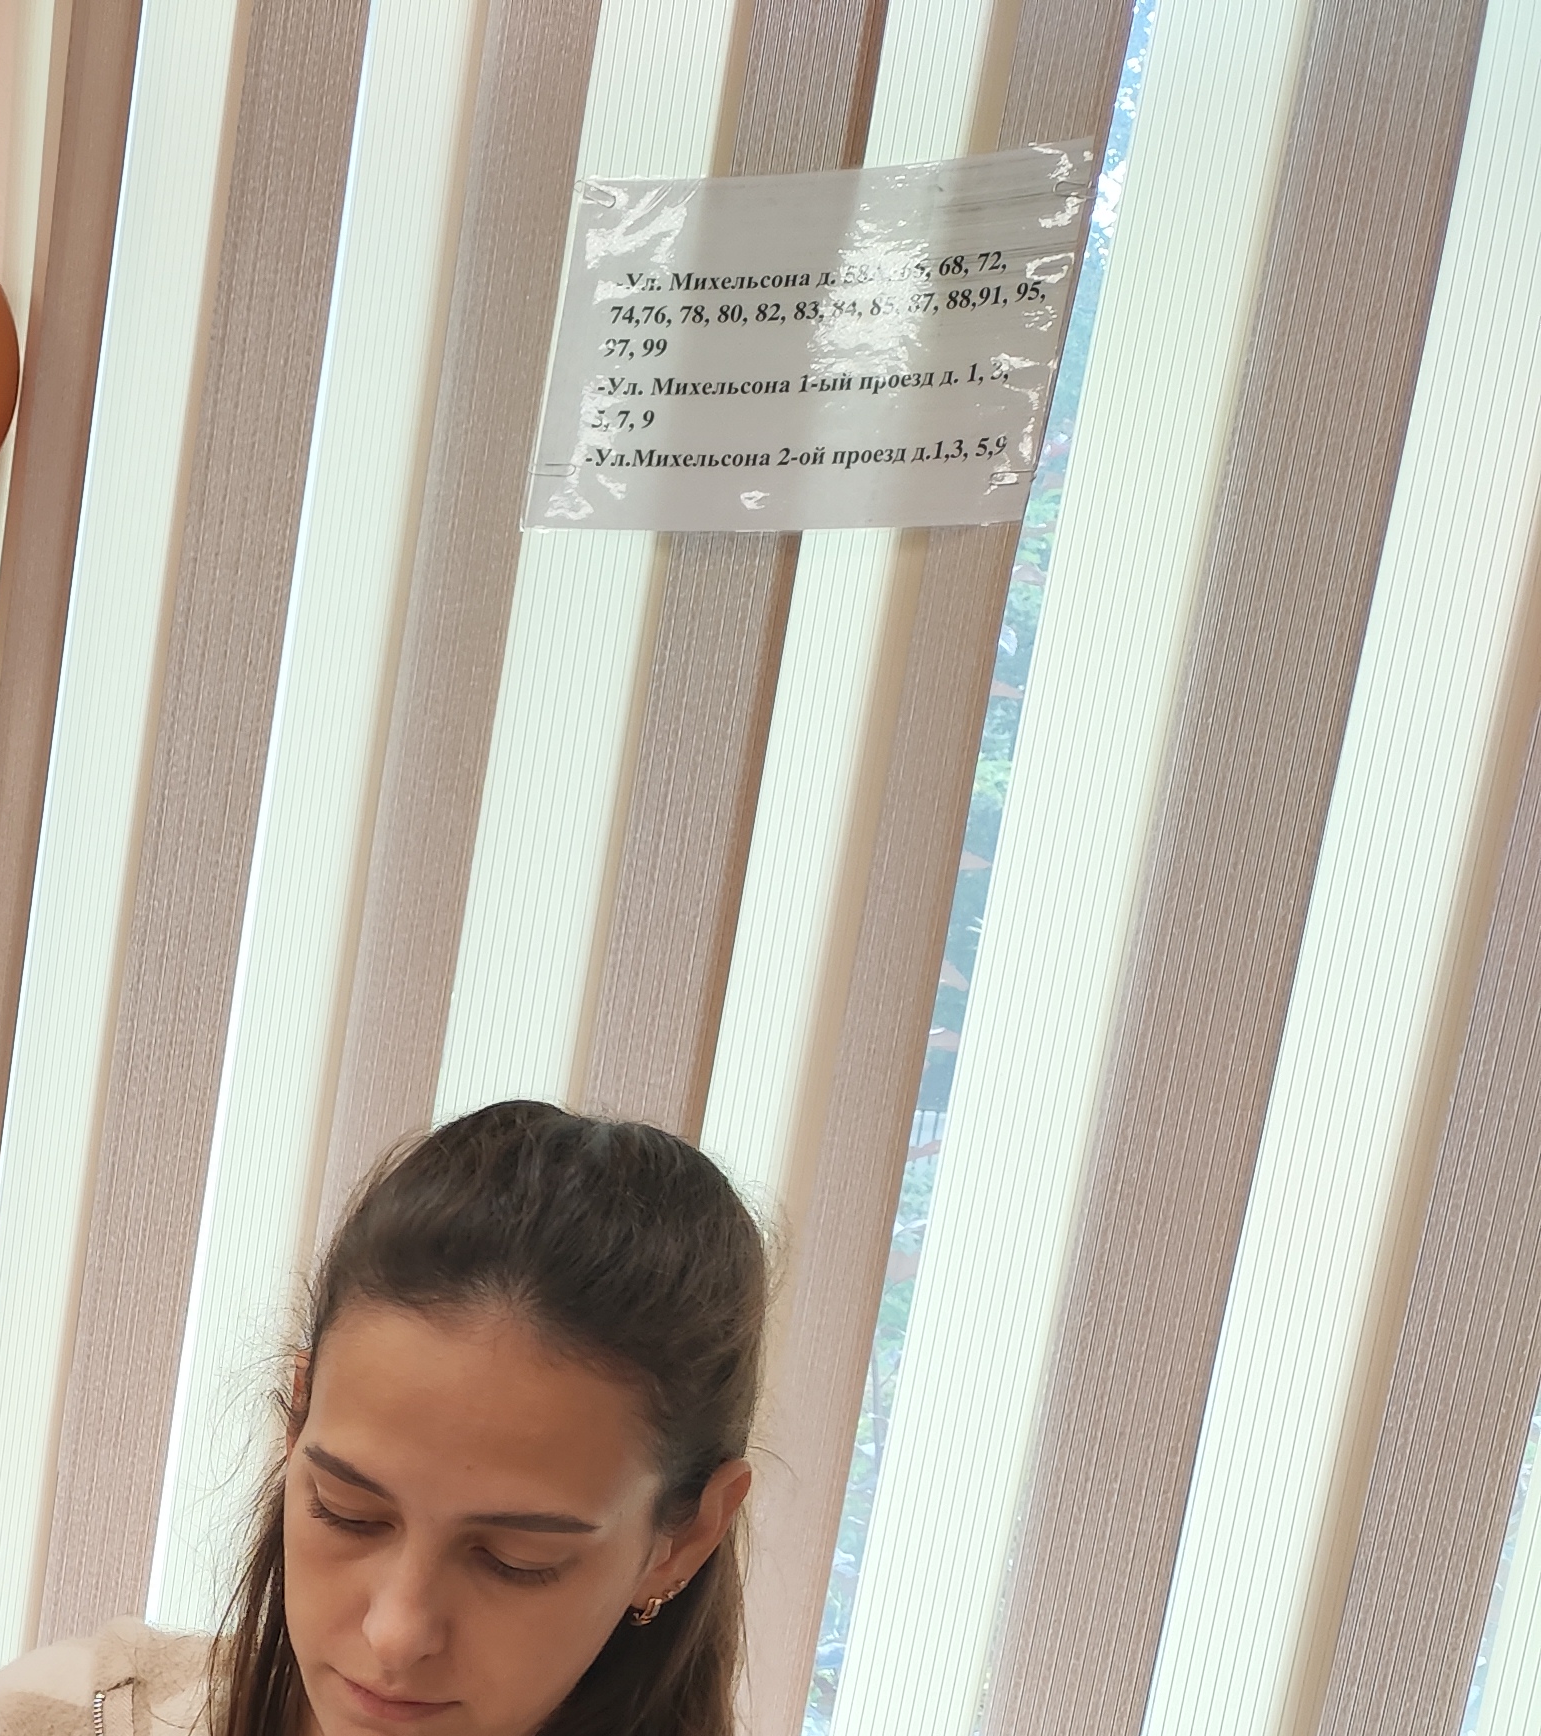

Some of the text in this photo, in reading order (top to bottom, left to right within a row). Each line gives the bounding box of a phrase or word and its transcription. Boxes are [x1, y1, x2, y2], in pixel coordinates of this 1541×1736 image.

[669, 272, 811, 292] Михельсона
[816, 271, 836, 288] д.
[939, 255, 969, 276] 68,
[977, 251, 1007, 272] 72,
[610, 305, 672, 328] 74,76,
[679, 305, 710, 327] 78,
[717, 304, 748, 326] 80,
[755, 303, 786, 324] 82,
[793, 301, 825, 322] 83,
[946, 286, 1008, 311] 88,91,
[1016, 281, 1046, 303] 95,
[641, 338, 668, 357] 99
[597, 377, 644, 396] -Ул.
[651, 377, 790, 396] Михельсона
[798, 372, 852, 394] 1-ый
[859, 372, 934, 394] проезд
[939, 370, 959, 387] д.
[967, 363, 984, 385] 1,
[617, 410, 634, 432] 7,
[641, 410, 655, 429] 9
[585, 448, 771, 468] -Ул.Михельсона
[777, 446, 825, 467] 2-ой
[831, 446, 906, 469] проезд
[911, 439, 968, 463] д.1,3,
